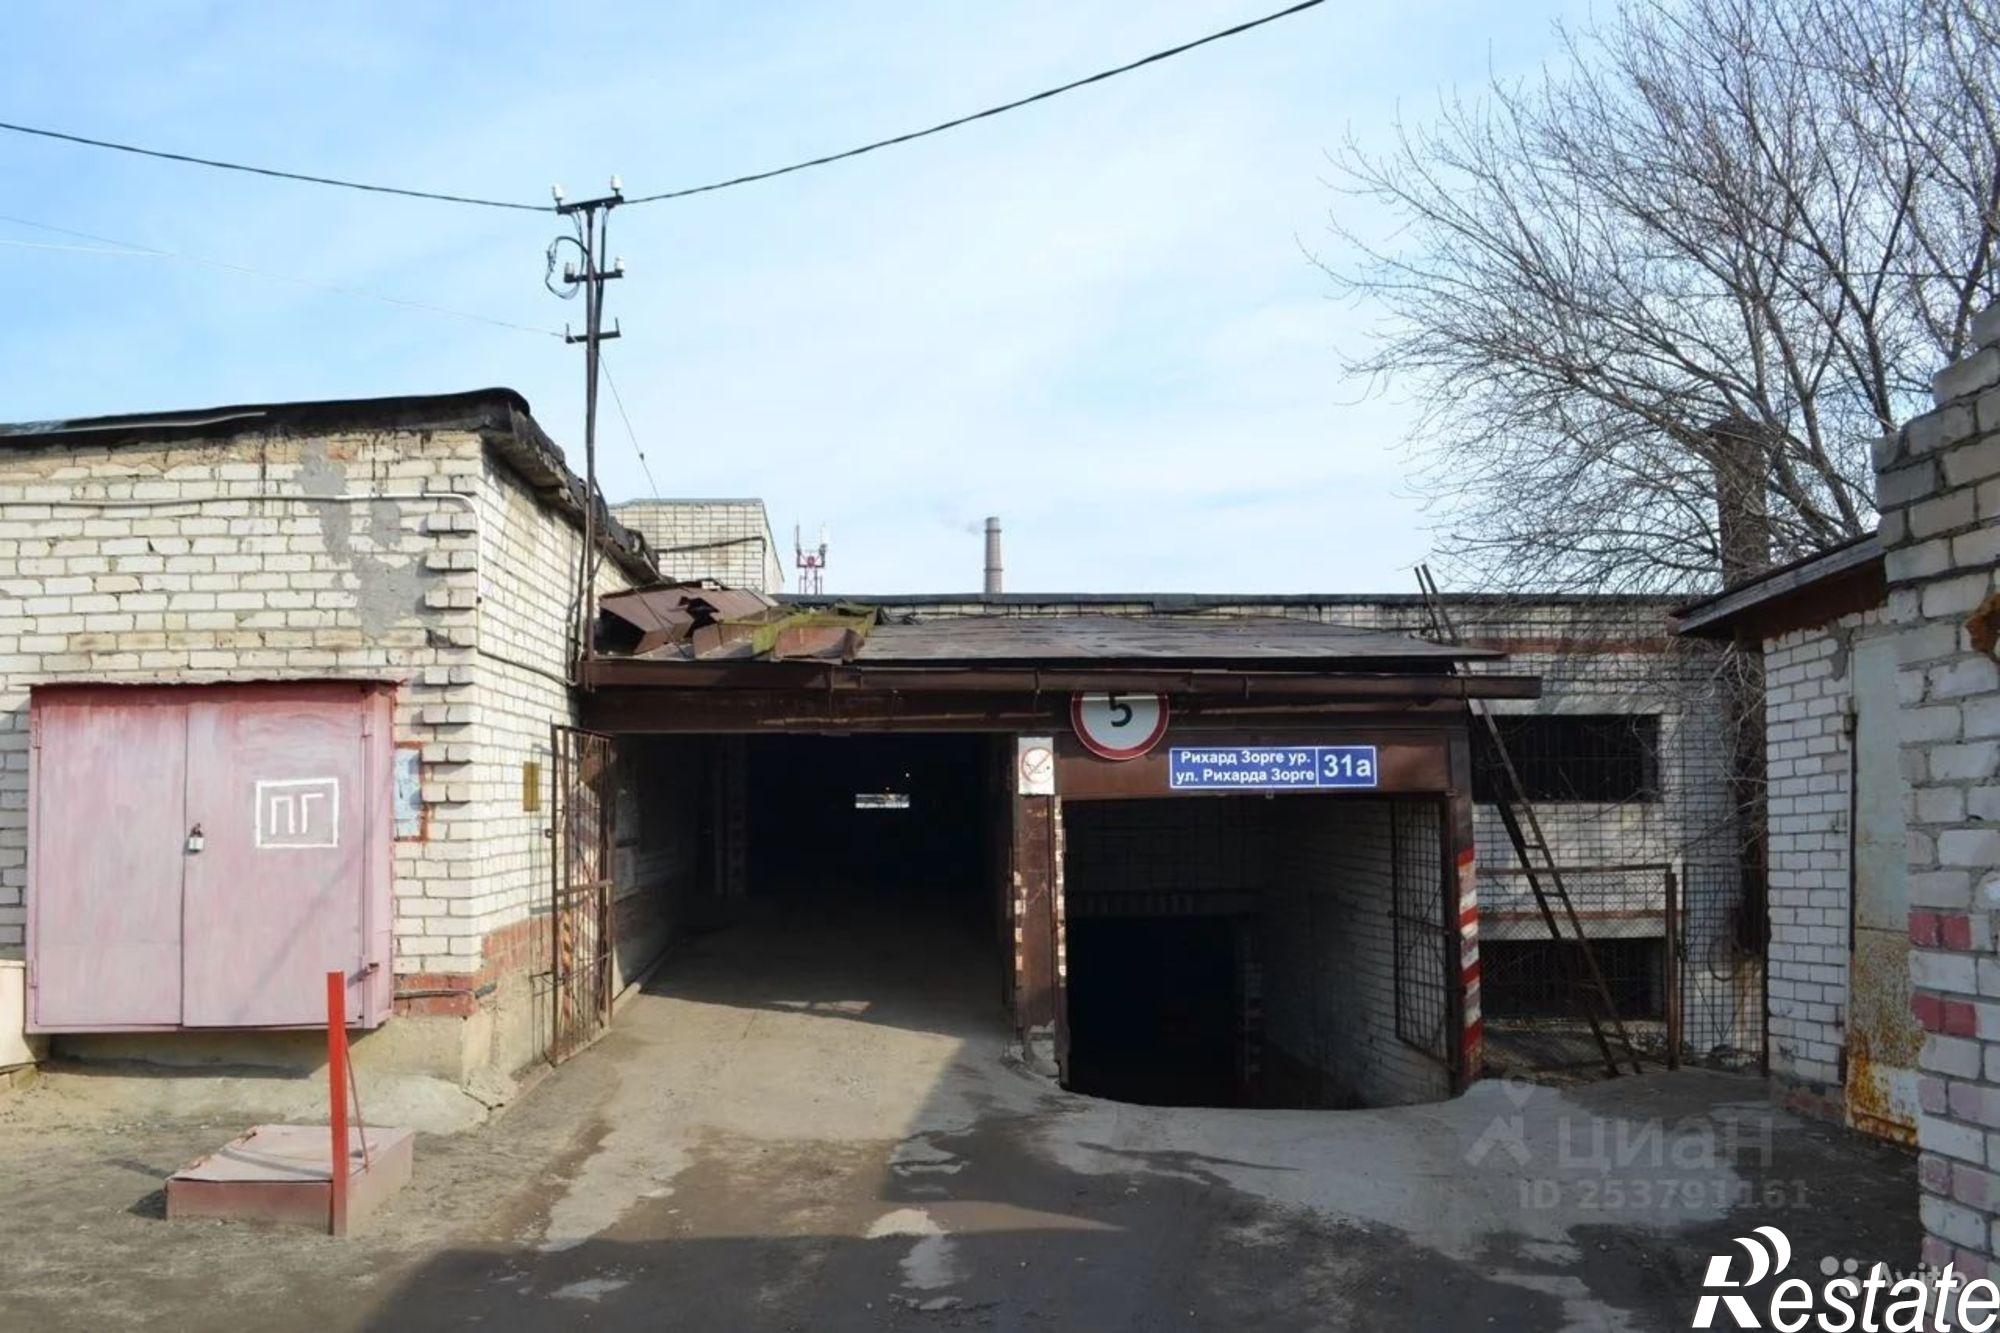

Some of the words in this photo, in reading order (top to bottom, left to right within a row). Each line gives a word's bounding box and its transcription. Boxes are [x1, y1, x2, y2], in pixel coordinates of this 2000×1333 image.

[1109, 692, 1133, 727] 5
[1181, 751, 1237, 766] Рихард
[1241, 750, 1284, 765] Зорге
[1288, 752, 1311, 766] ур.
[1323, 754, 1371, 777] 31а
[1176, 772, 1198, 785] ул.
[1203, 768, 1267, 783] Рихарда
[1271, 768, 1314, 783] Зорге
[270, 793, 324, 834] ПГ
